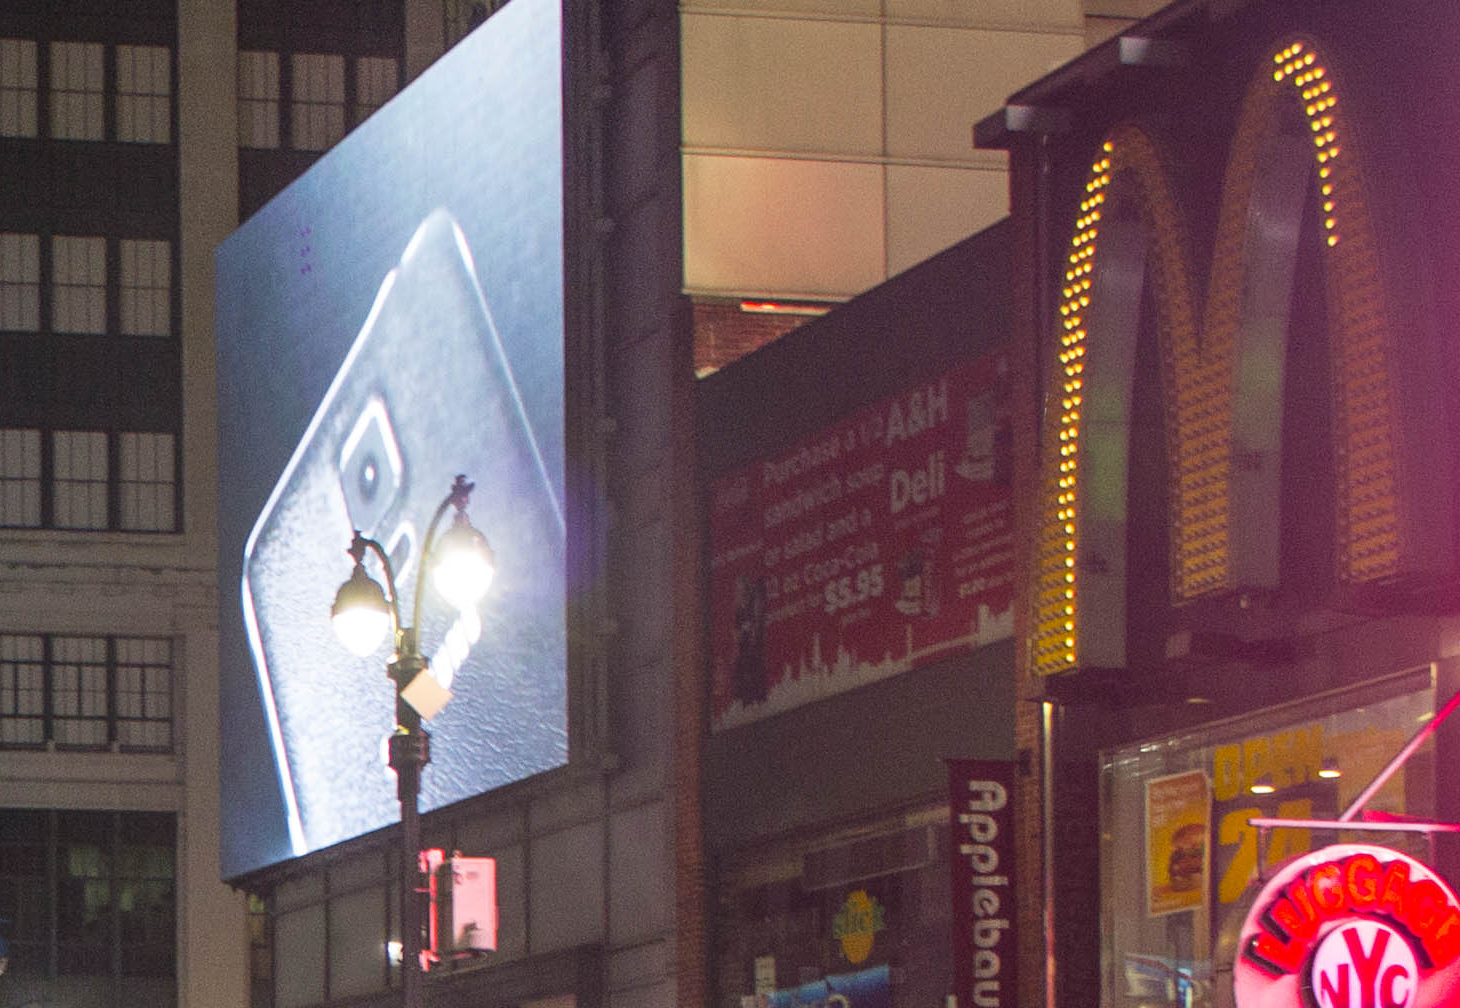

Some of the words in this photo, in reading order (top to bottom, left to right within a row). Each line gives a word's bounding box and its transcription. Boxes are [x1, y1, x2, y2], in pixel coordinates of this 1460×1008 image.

[884, 380, 946, 448] A&H
[890, 449, 946, 515] Deli
[822, 563, 885, 616] $5.95
